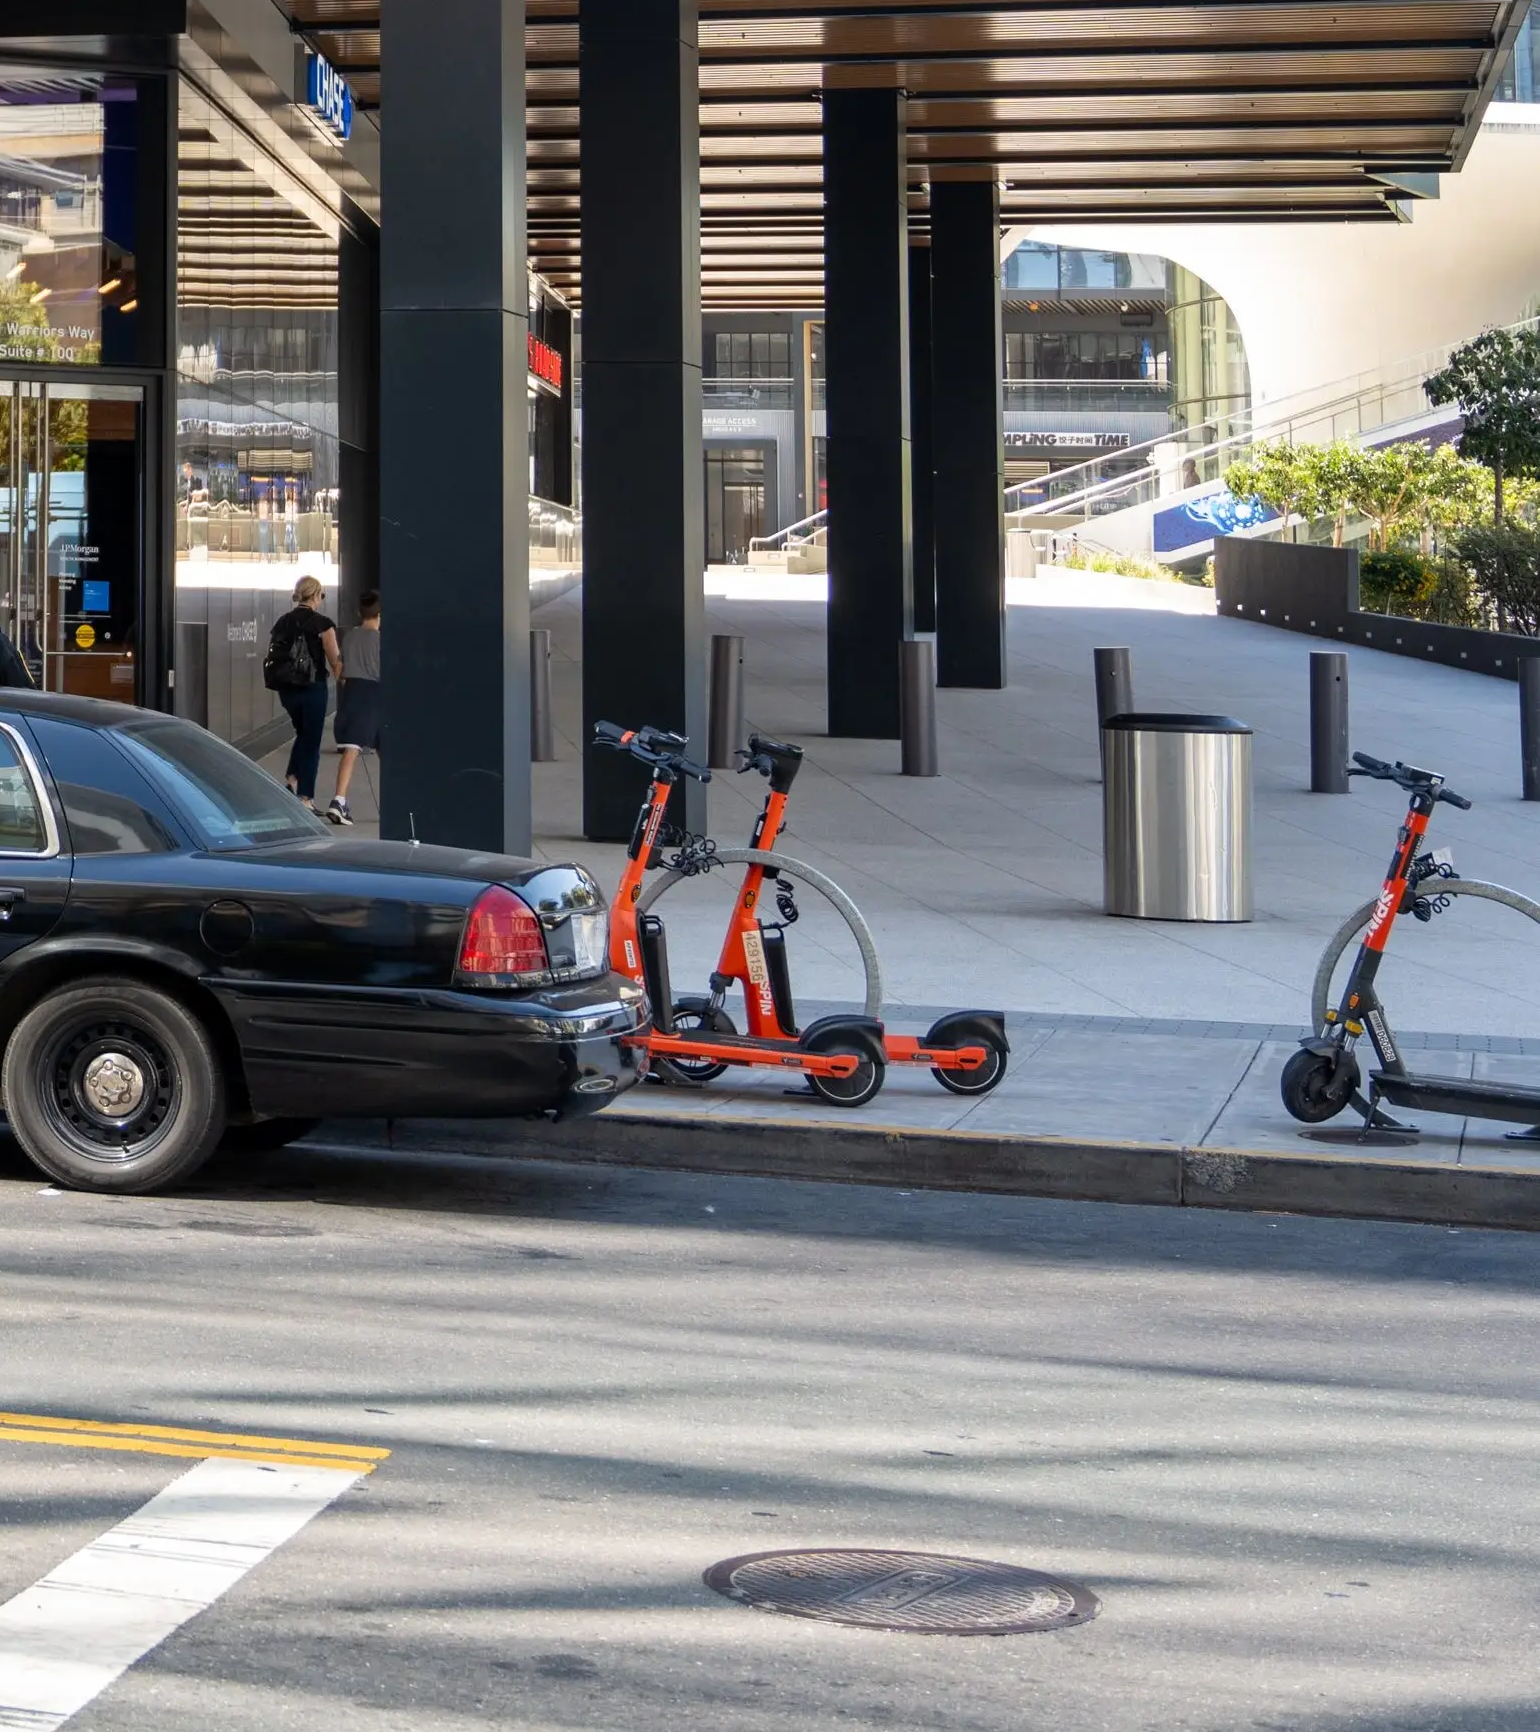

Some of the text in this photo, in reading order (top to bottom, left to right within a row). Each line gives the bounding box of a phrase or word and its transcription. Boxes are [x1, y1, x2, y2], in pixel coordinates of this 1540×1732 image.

[317, 53, 344, 132] CHASE
[6, 321, 65, 338] Warriors
[68, 325, 95, 340] Way
[759, 980, 772, 1016] SPIN
